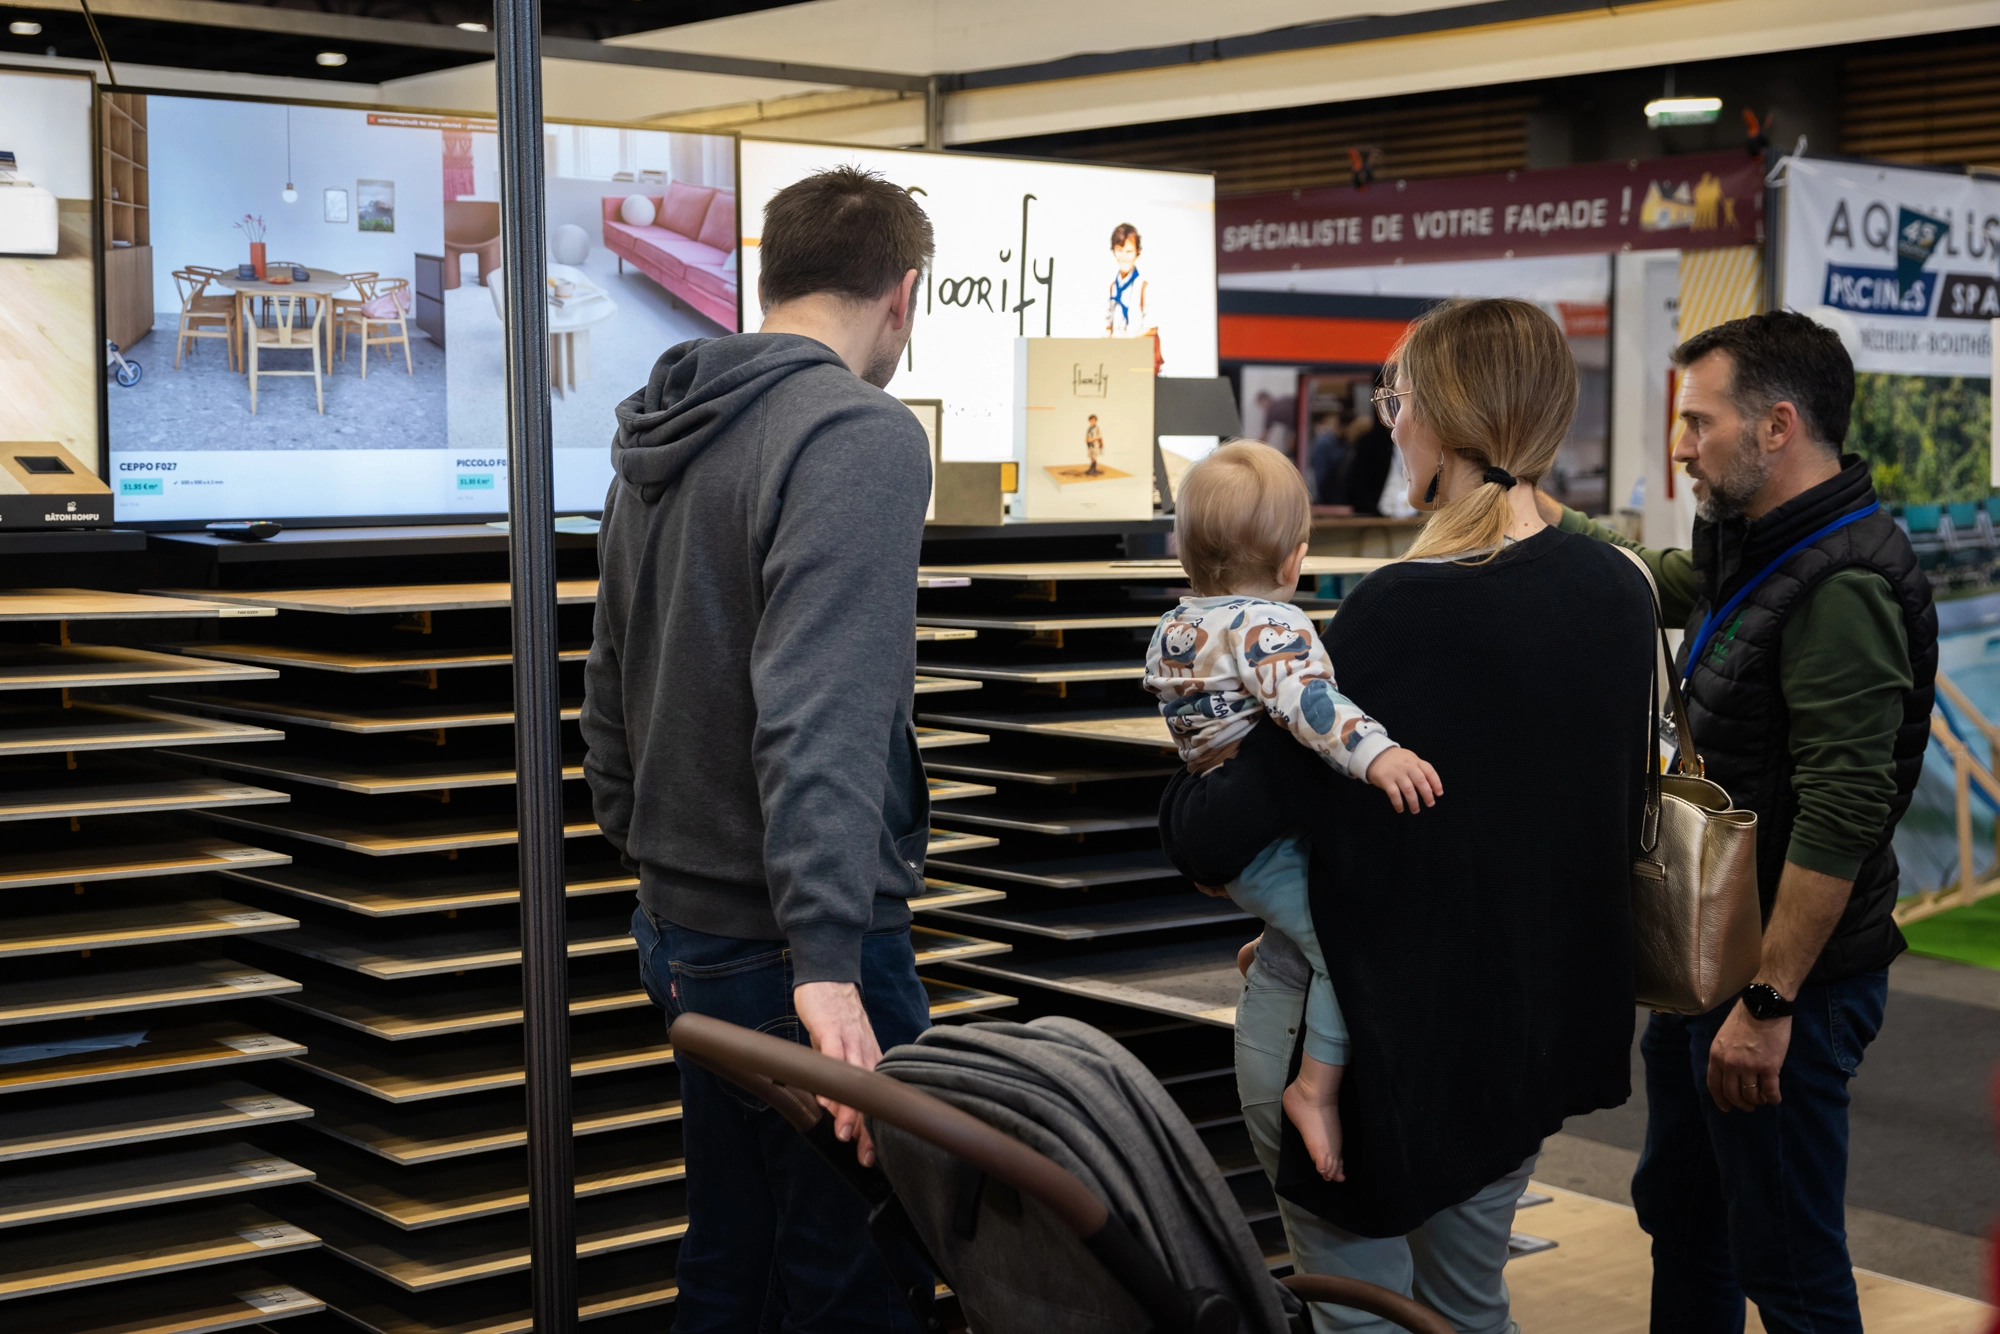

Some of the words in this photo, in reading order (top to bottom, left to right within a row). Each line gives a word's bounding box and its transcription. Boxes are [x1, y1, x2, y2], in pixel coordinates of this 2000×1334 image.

[1221, 215, 1362, 252] SPÉCIALISTE
[1371, 214, 1403, 243] DE
[1413, 207, 1494, 240] VOTRE
[1504, 198, 1608, 236] FAÇADE
[1620, 185, 1632, 225] !
[1826, 199, 2000, 259] AQLUS
[119, 462, 153, 471] CEPPO
[155, 462, 177, 471] F027
[456, 458, 495, 467] PICCOLO
[45, 512, 71, 521] BÂTON
[71, 513, 100, 521] ROMPU
